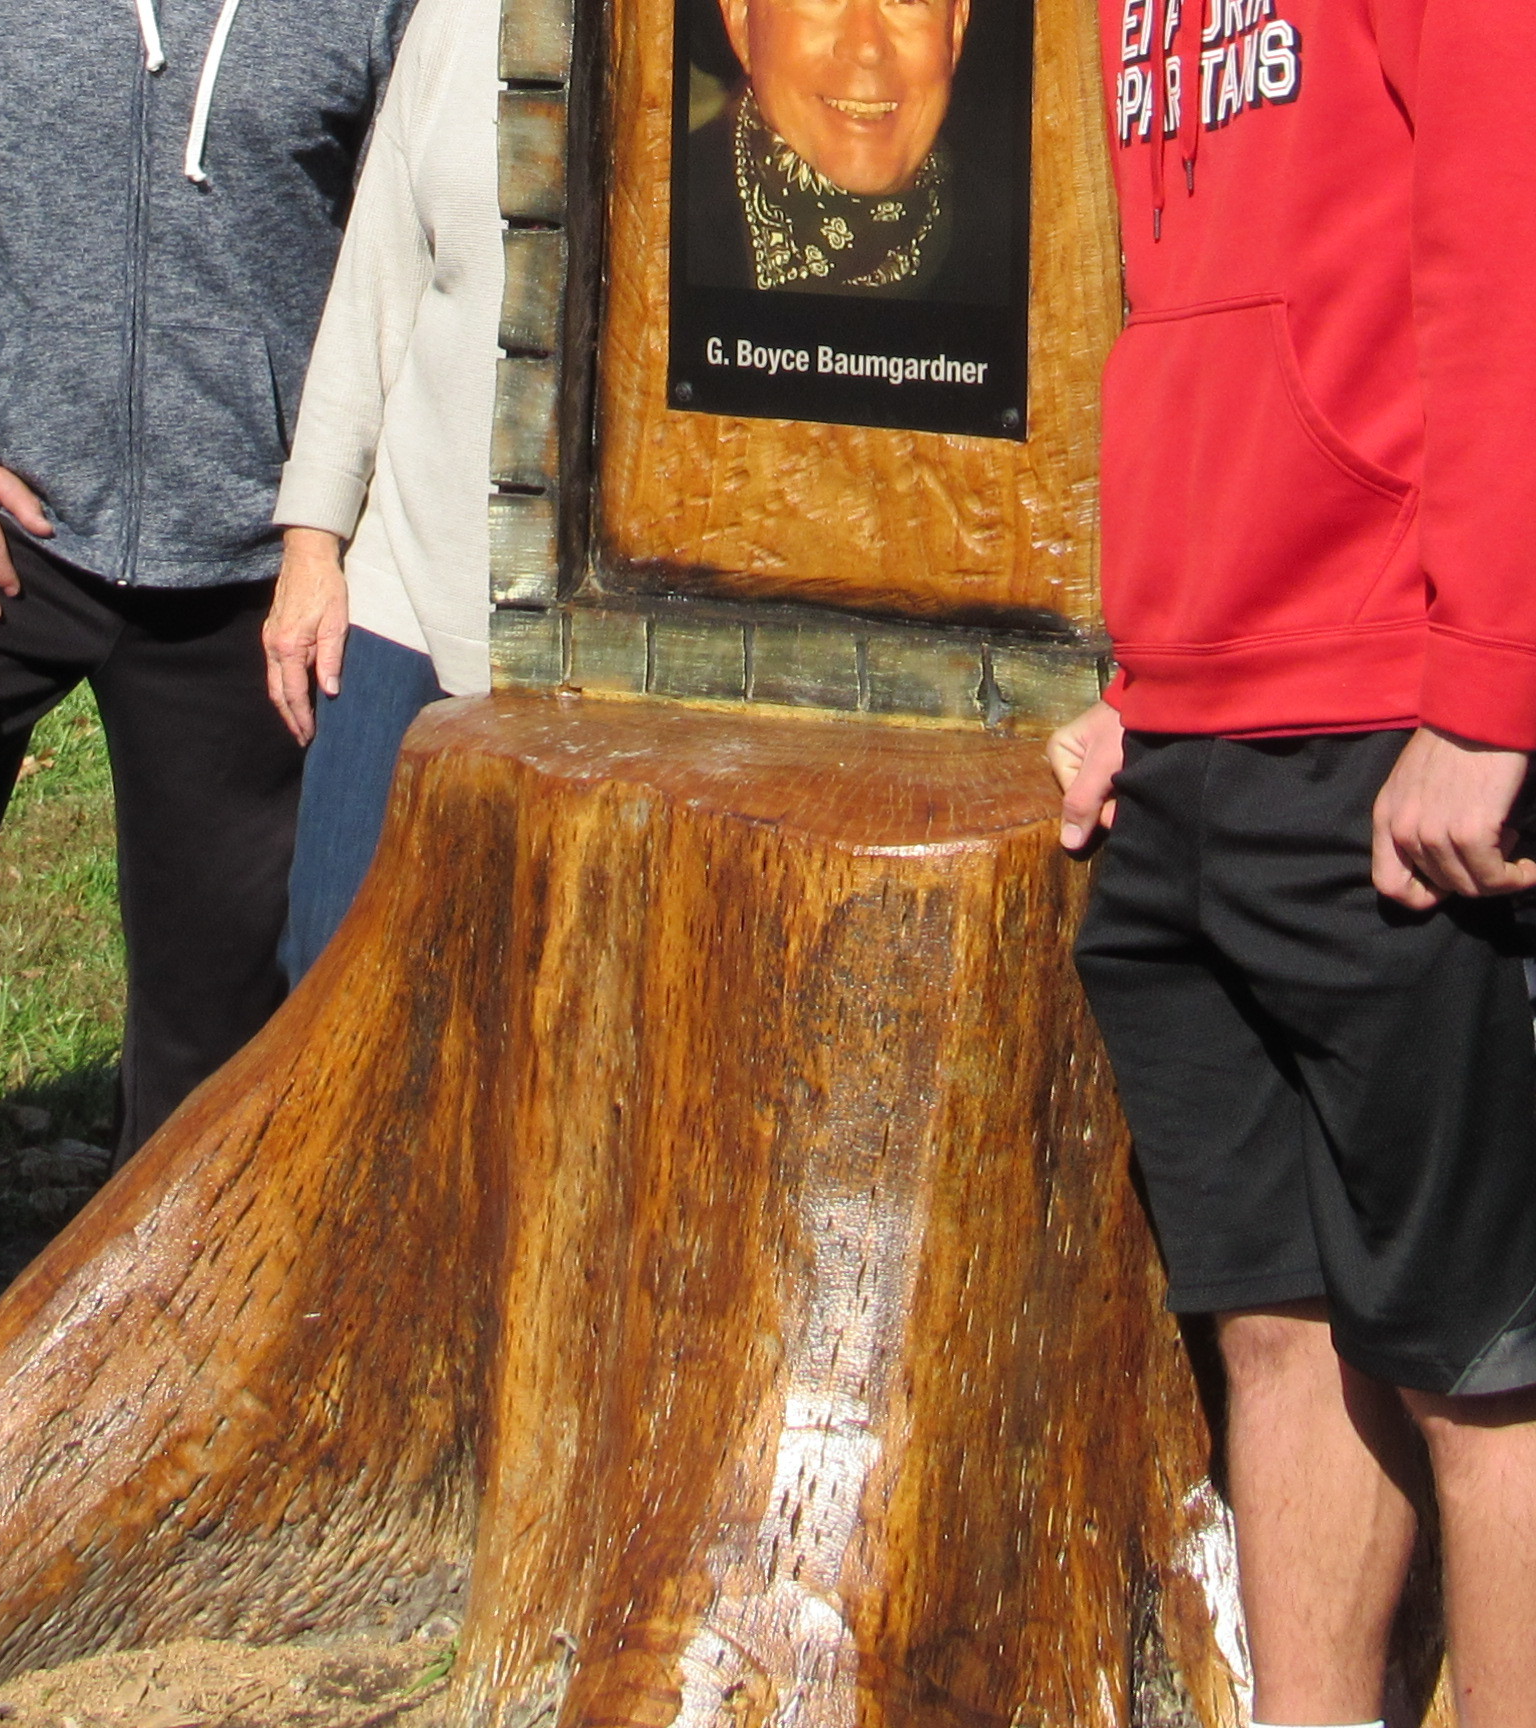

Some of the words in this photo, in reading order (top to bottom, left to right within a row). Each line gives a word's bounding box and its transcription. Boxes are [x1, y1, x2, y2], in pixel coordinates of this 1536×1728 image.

[706, 337, 729, 366] G.
[737, 339, 809, 375] Boyce
[817, 346, 988, 385] Baumgardner
